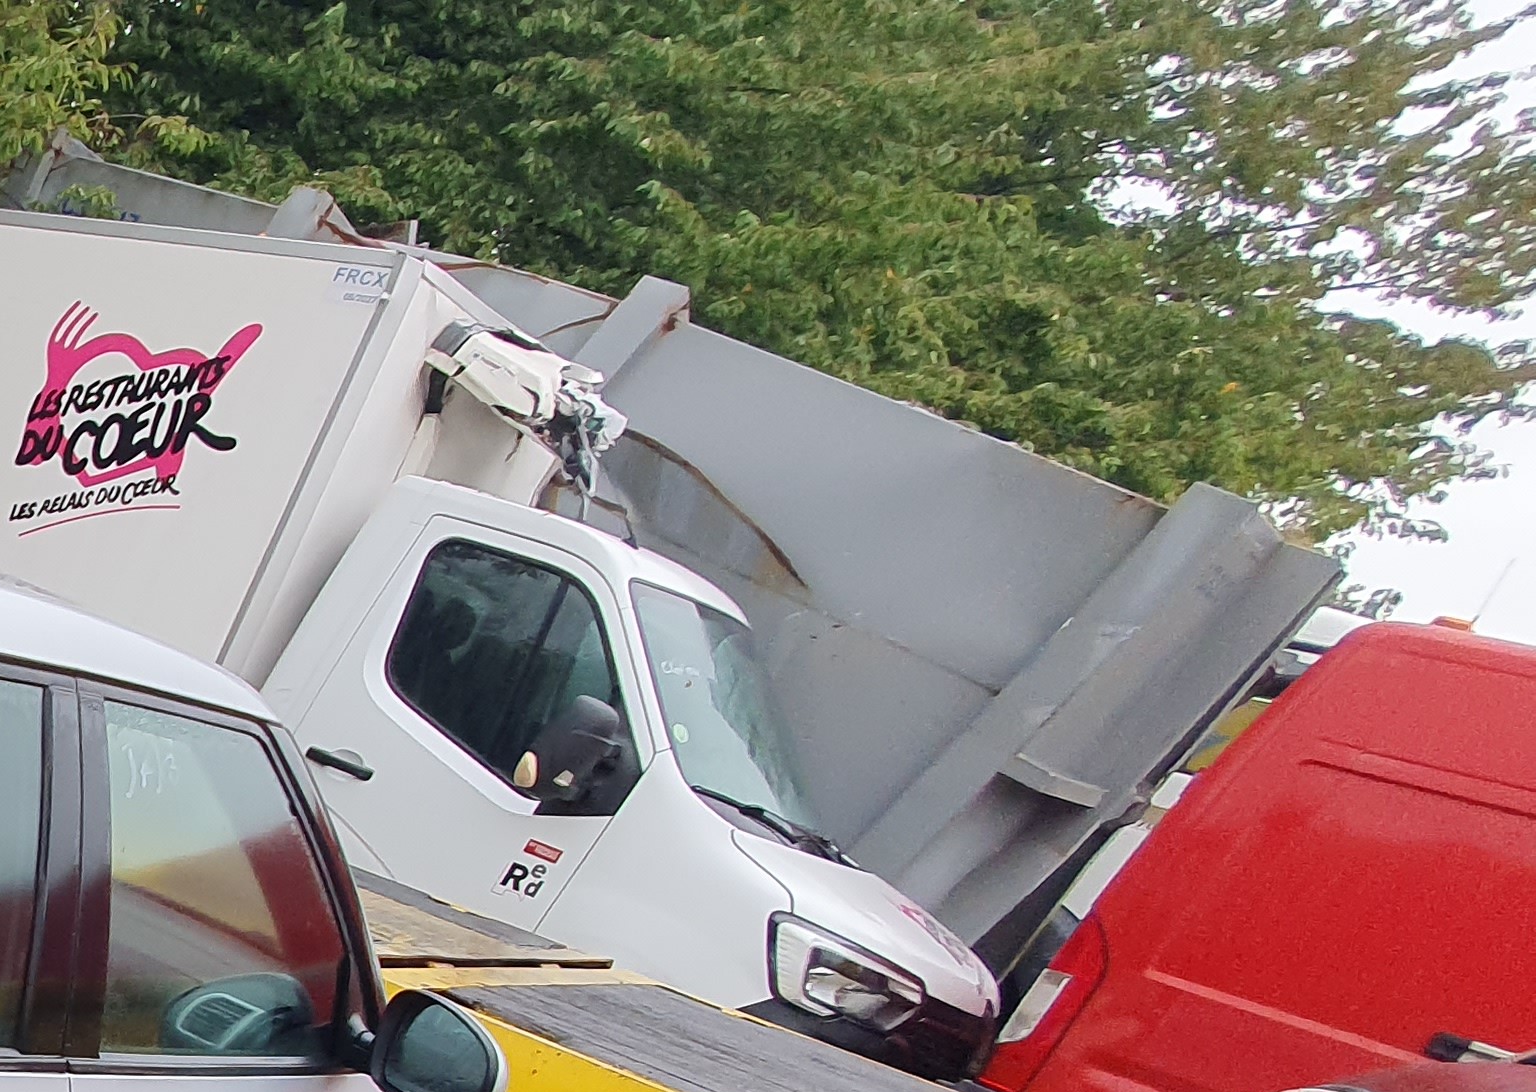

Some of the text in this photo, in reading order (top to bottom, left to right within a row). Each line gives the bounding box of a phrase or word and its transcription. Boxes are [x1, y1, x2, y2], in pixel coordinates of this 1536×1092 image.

[332, 266, 389, 288] FRCX
[28, 355, 233, 424] LES RESTAURANTS
[14, 424, 65, 466] DU
[8, 502, 38, 522] LES
[37, 490, 94, 518] RELAIS
[94, 483, 121, 506] DU
